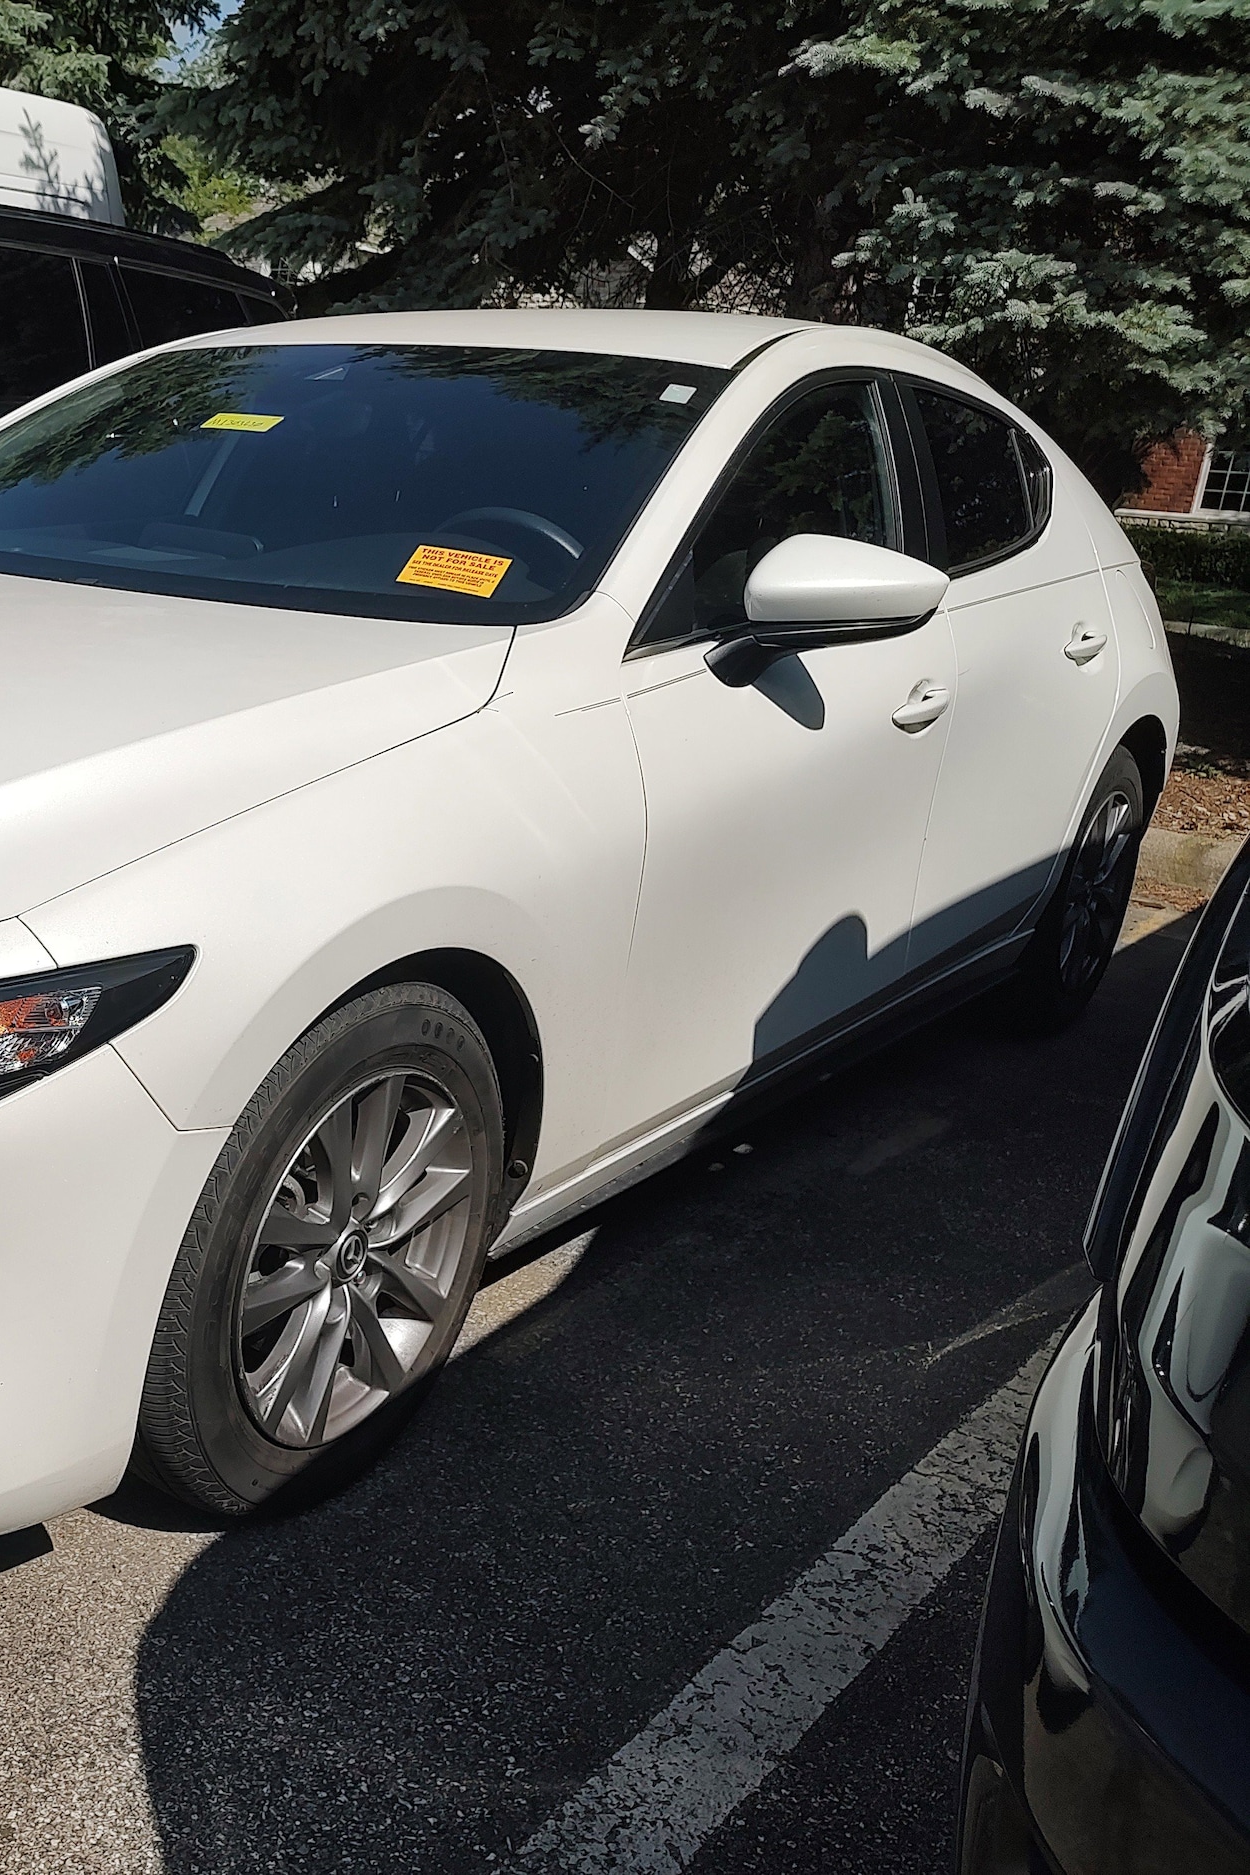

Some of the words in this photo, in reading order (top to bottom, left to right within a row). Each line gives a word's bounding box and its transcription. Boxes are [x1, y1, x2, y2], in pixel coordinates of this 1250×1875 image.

[422, 548, 445, 556] THIS
[448, 552, 491, 564] VEHICLE
[469, 562, 496, 571] SALE
